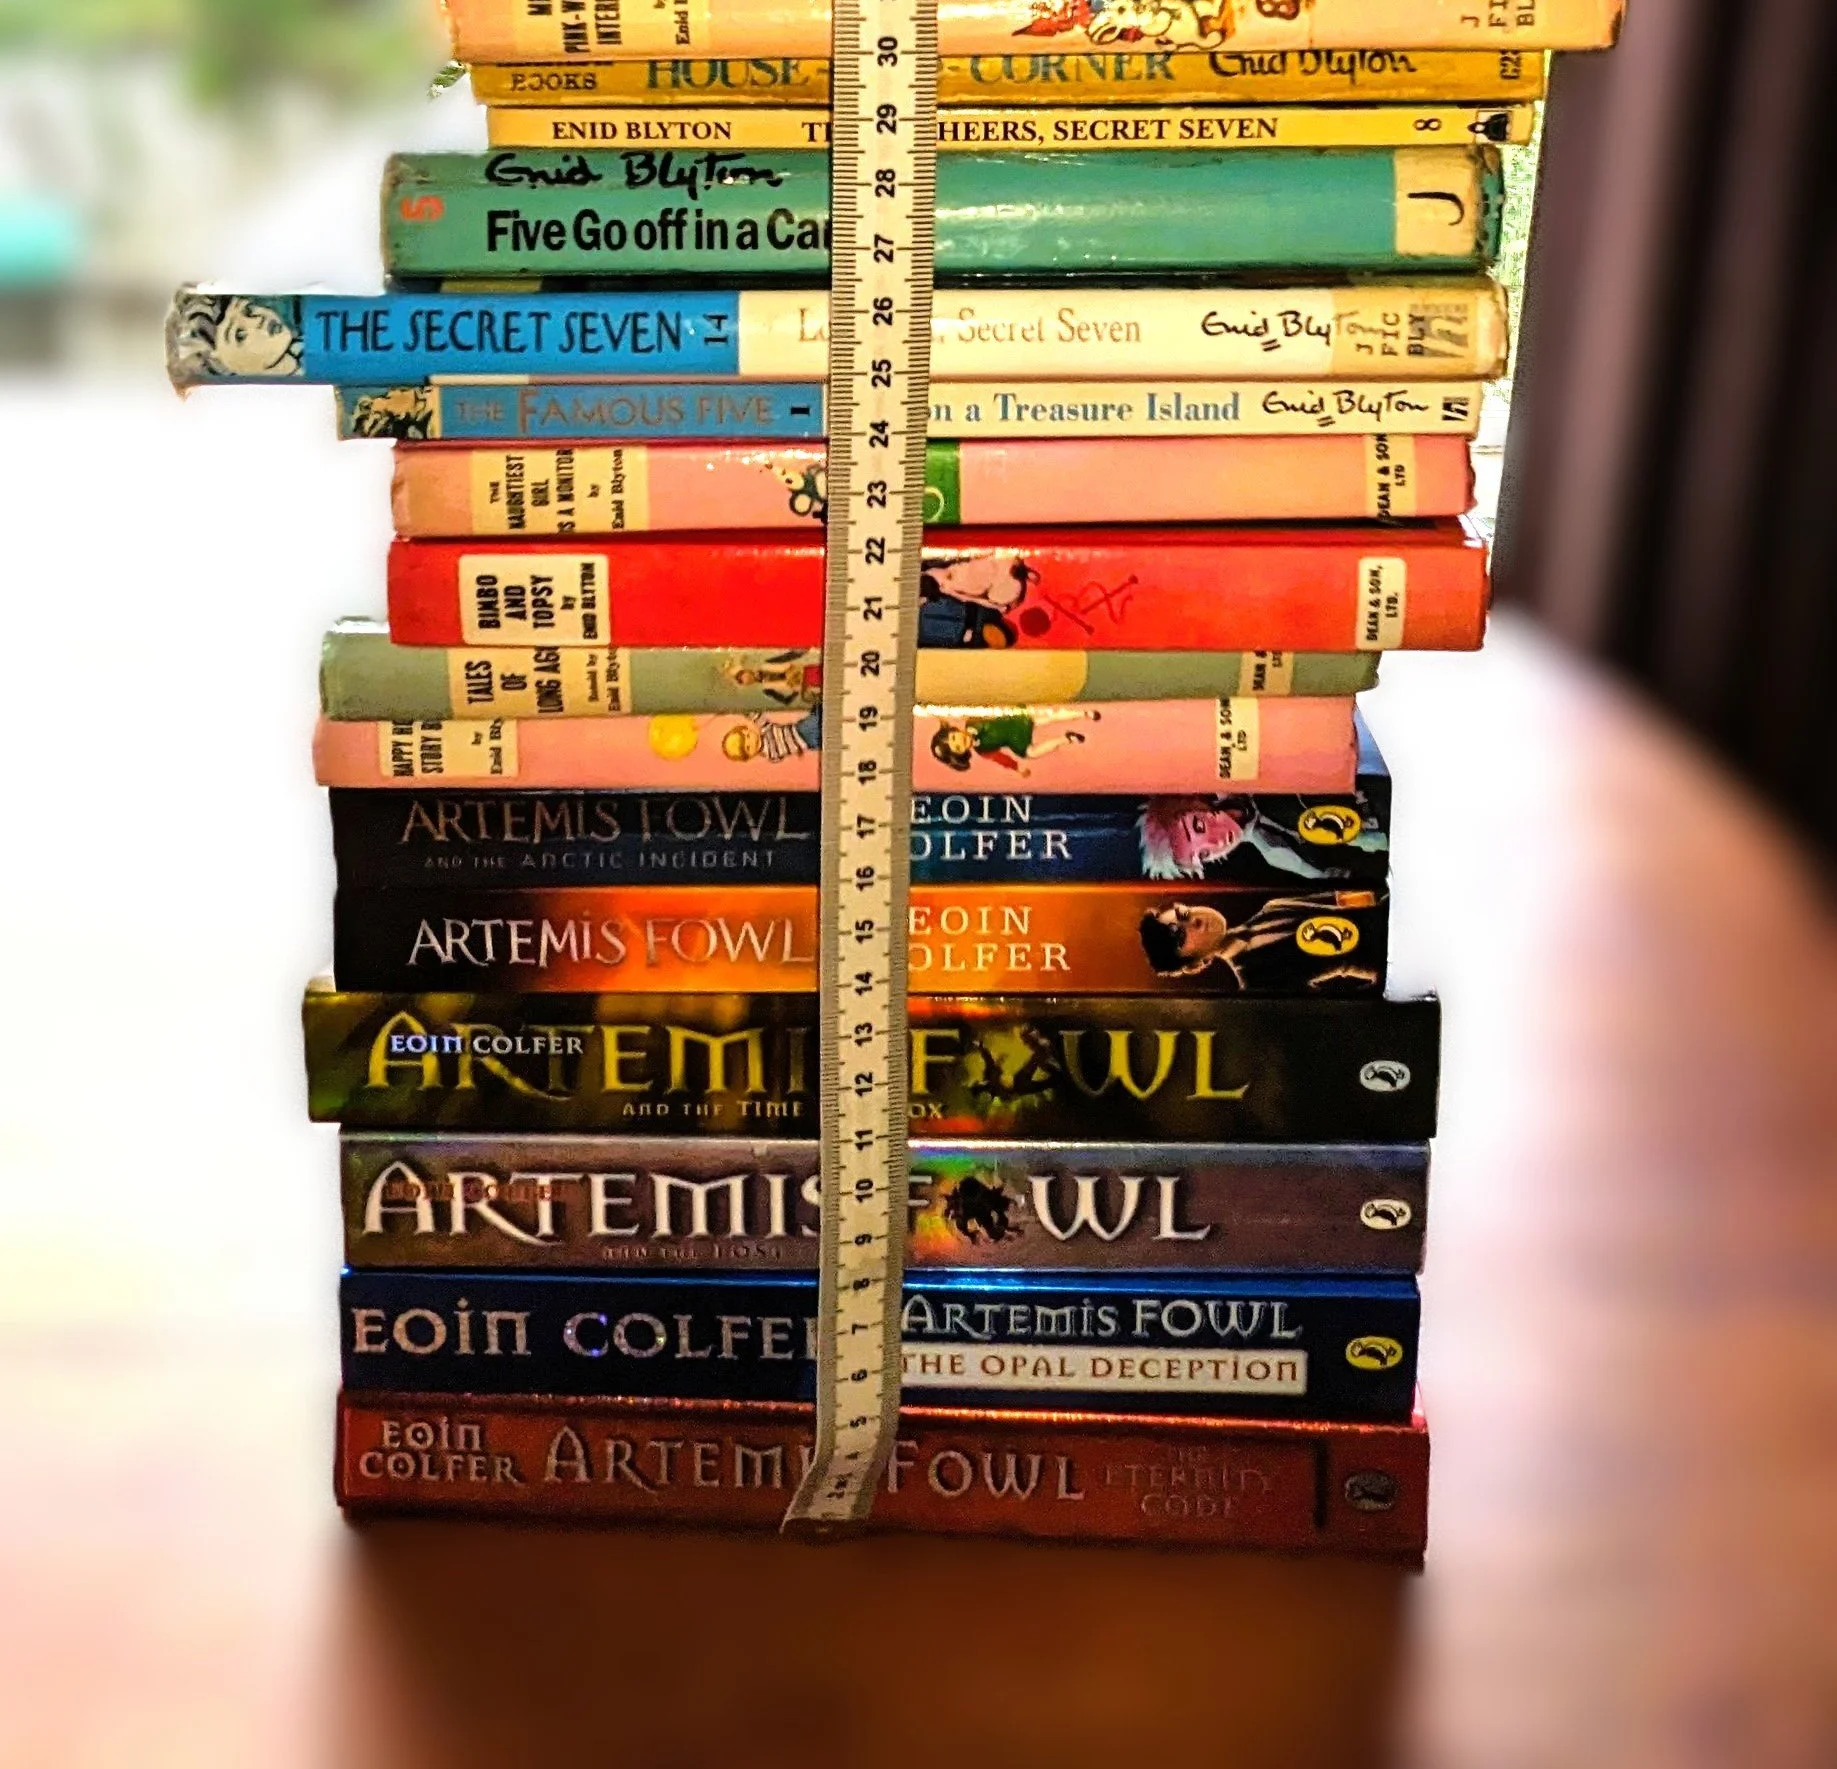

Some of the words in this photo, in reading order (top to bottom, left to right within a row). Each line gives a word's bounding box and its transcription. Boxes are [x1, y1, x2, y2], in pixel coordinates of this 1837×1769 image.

[675, 10, 690, 45] Enid
[877, 36, 899, 67] 30
[551, 121, 618, 141] ENID
[625, 121, 733, 143] BLYTON
[938, 120, 1046, 144] HEERS,
[1053, 118, 1169, 142] SECRET
[1178, 118, 1278, 139] SEVEN
[1413, 118, 1442, 131] 8
[485, 155, 602, 188] Enid
[620, 153, 783, 199] Blyton
[875, 168, 896, 199] 28
[487, 211, 565, 251] Five
[572, 210, 628, 251] Go
[633, 209, 688, 249] off
[695, 209, 729, 249] in
[736, 220, 760, 249] a
[873, 233, 895, 263] 27
[316, 310, 390, 353] THE
[405, 311, 550, 353] SECRET
[559, 310, 683, 351] SEVEN
[703, 313, 730, 345] 14
[958, 308, 1045, 342] Secret
[1059, 309, 1141, 342] Seven
[1201, 311, 1269, 340] Enid
[1381, 312, 1400, 356] FIC
[1407, 313, 1425, 355] BLY
[871, 358, 892, 388] 25
[456, 401, 503, 421] THE
[519, 390, 684, 433] FAMOUS
[698, 397, 772, 425] FIVE
[965, 404, 981, 421] a
[993, 393, 1133, 422] Treasure
[1145, 391, 1240, 421] Island
[1262, 390, 1326, 417] Enid
[1332, 390, 1429, 422] Blyton
[869, 420, 890, 448] 24
[1395, 464, 1405, 486] LTD
[506, 455, 525, 529] NAUGHTIEST
[865, 537, 885, 565] 22
[580, 562, 596, 609] BLYTON
[476, 575, 501, 628] BIMBO
[504, 585, 526, 620] AND
[530, 575, 555, 628] TOPSY
[560, 595, 576, 610] by
[863, 596, 882, 620] 21
[1367, 606, 1378, 641] DEAN
[861, 650, 881, 677] 20
[465, 661, 494, 704] TALES
[501, 673, 527, 690] OF
[535, 679, 564, 713] LONG
[859, 706, 878, 732] 19
[420, 736, 443, 773] STORY
[858, 759, 877, 785] 18
[401, 797, 621, 845] ARTEMIS
[641, 796, 815, 841] FOWL
[911, 795, 1033, 824] EOIN
[856, 813, 876, 839] 17
[424, 856, 463, 869] AND
[473, 856, 505, 869] THE
[522, 852, 623, 868] ARCTIC
[639, 850, 777, 868] INCIDENT
[911, 831, 1072, 860] OLFER
[856, 865, 875, 892] 16
[855, 919, 874, 945] 15
[909, 906, 1032, 935] EOIN
[407, 911, 627, 968] ARTEMIS
[644, 919, 815, 967] FOWL
[909, 944, 1070, 972] OLFER
[855, 971, 873, 996] 14
[390, 1035, 462, 1054] EOIN
[472, 1036, 585, 1055] COLFER
[854, 1022, 873, 1046] 13
[365, 1010, 809, 1100] ARTEMI
[855, 1071, 874, 1096] 12
[622, 1102, 669, 1116] AND
[683, 1103, 724, 1116] THE
[737, 1100, 804, 1117] TIME
[855, 1129, 874, 1151] 11
[855, 1178, 874, 1203] 10
[350, 1297, 531, 1356] EOIN
[901, 1294, 1120, 1340] ARTEMIS
[1132, 1299, 1303, 1338] FOWL
[901, 1352, 964, 1376] THE
[980, 1355, 1075, 1377] OPAL
[1091, 1357, 1298, 1381] DECEPTION
[381, 1417, 482, 1450] EOIN
[359, 1451, 525, 1486] COLFER
[887, 1440, 1085, 1501] FOWL
